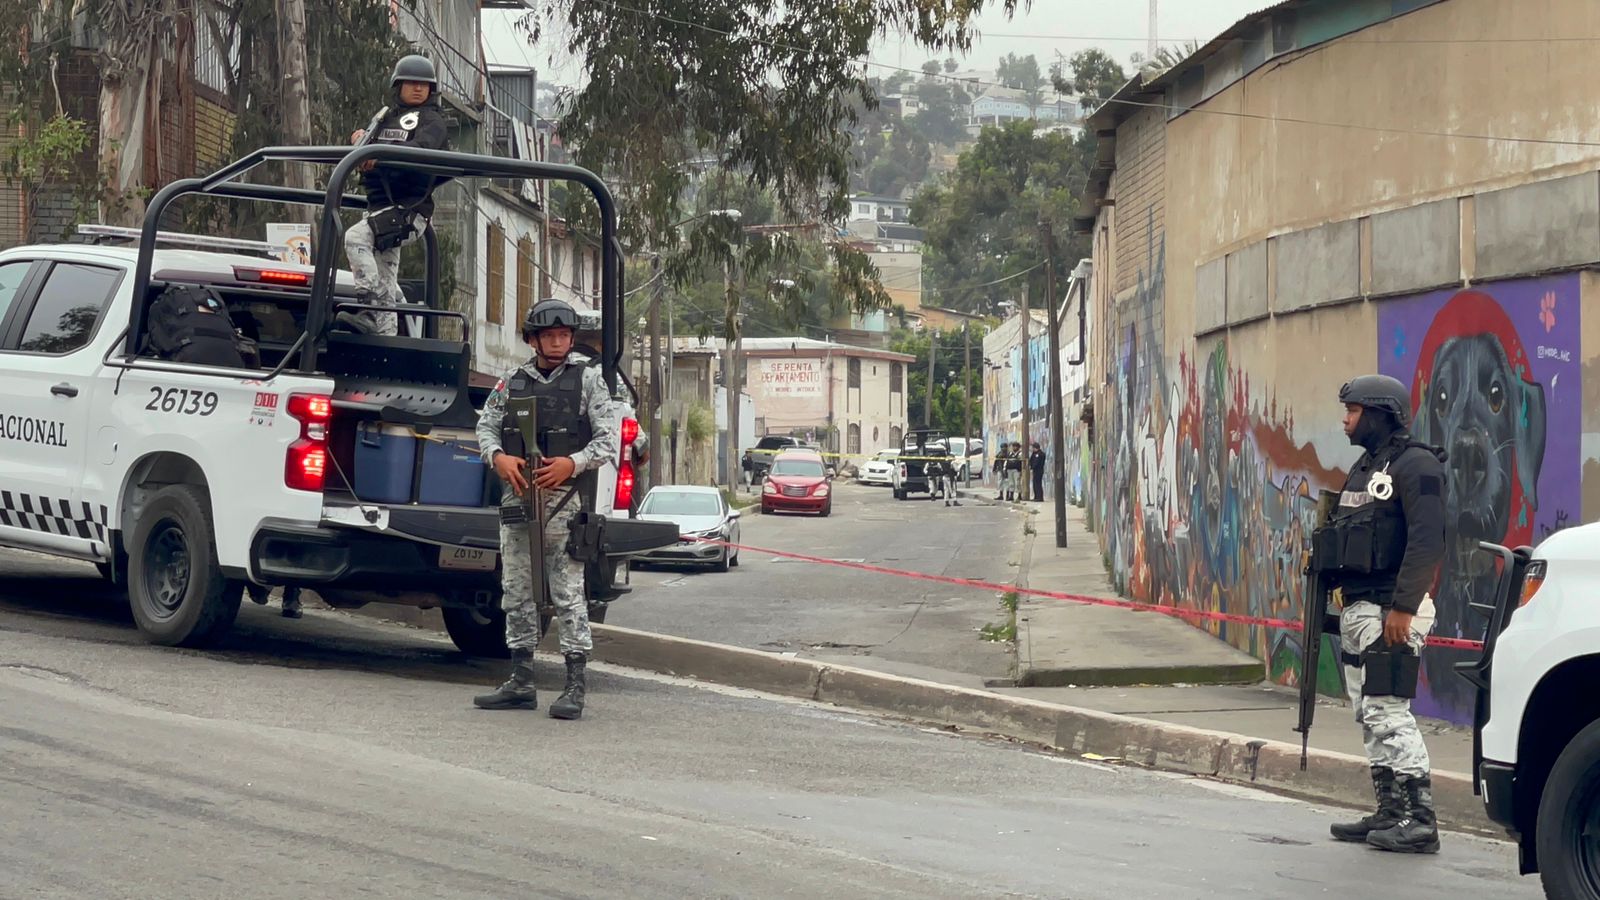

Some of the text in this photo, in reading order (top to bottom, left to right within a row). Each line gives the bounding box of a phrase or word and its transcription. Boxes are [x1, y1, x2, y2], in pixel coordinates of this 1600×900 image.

[771, 363, 813, 372] SE RENTA
[146, 386, 219, 416] 26139
[256, 394, 277, 407] 911
[0, 413, 68, 447] ACIONAL
